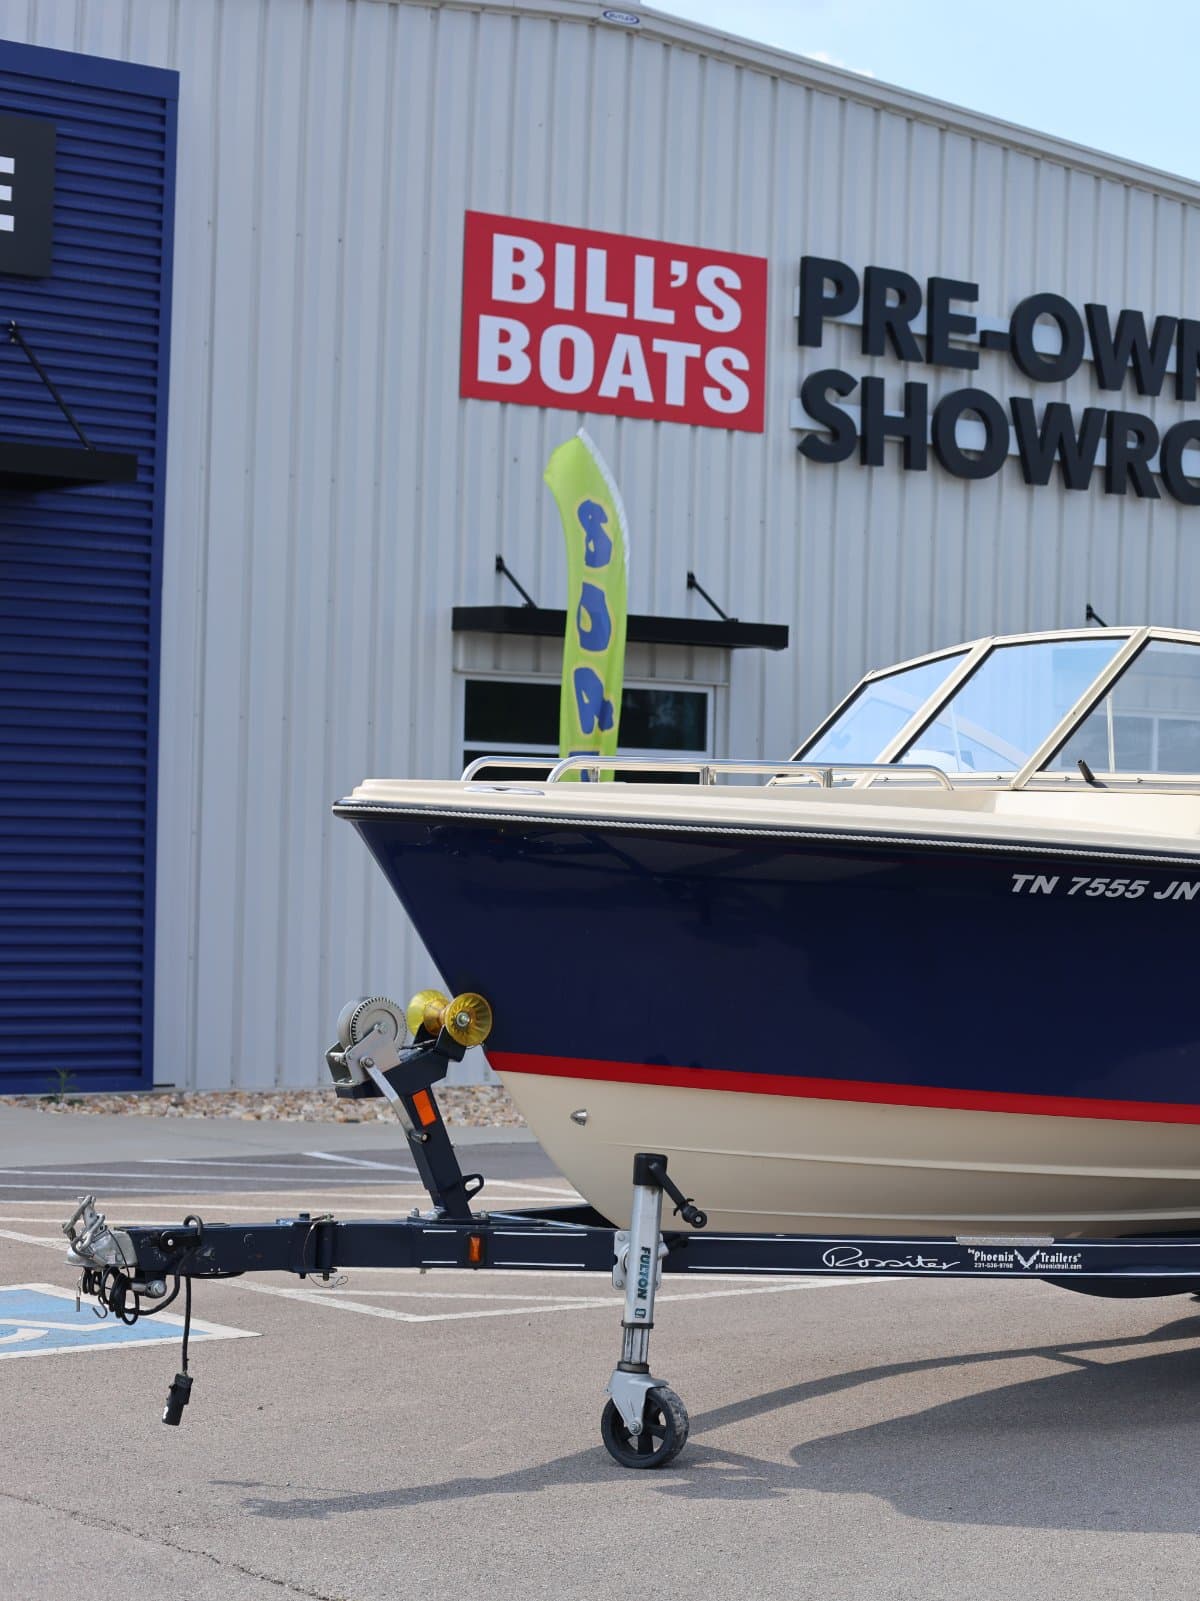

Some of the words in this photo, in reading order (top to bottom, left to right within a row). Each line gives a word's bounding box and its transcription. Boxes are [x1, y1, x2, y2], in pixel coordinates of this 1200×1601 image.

[491, 232, 742, 333] BILL'S
[477, 314, 750, 414] BOATS
[1011, 874, 1059, 894] TN
[1067, 876, 1150, 899] 7555
[637, 1246, 651, 1299] FULTON
[822, 1246, 961, 1270] Rossiter
[974, 1251, 1014, 1262] Phoenix
